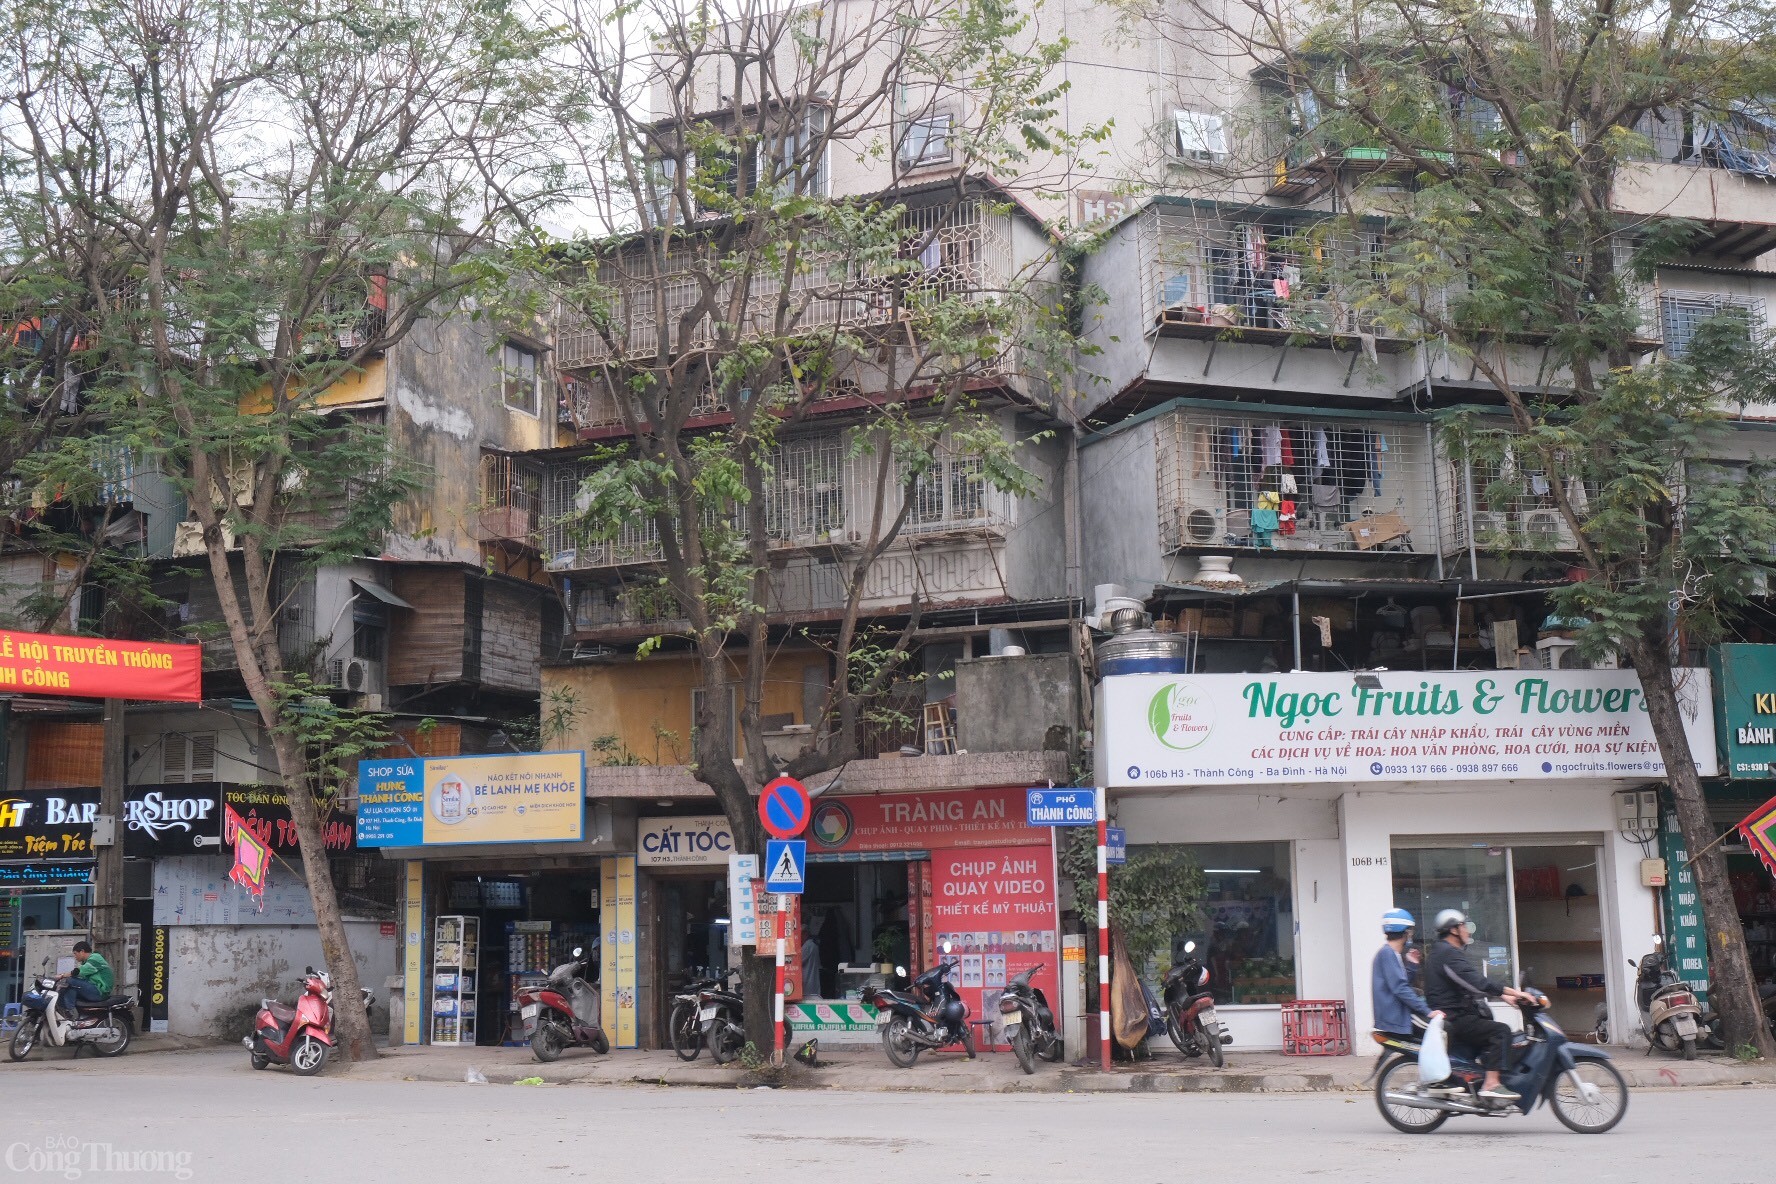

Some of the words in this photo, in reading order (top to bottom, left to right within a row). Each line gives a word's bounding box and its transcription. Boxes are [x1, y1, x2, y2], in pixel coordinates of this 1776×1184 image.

[18, 641, 49, 664] HỘI
[52, 643, 118, 666] TRUYỀN
[121, 648, 173, 670] THỐNG
[22, 666, 70, 688] CÔNG
[1242, 682, 1343, 728] Ngọc
[1351, 682, 1463, 716] Fruits
[1472, 678, 1505, 715] &
[1171, 713, 1192, 721] Fruits
[1173, 724, 1179, 732] &
[1181, 723, 1208, 732] Flowers
[1279, 730, 1314, 741] CUNG
[1318, 725, 1346, 741] CẤP:
[1351, 727, 1379, 740] TRÁI
[1383, 727, 1407, 740] CÂY
[1410, 726, 1446, 741] NHẬP
[1450, 723, 1490, 740] KHẨU,
[1495, 725, 1524, 738] TRÁI
[1531, 725, 1555, 738] CÂY
[1558, 723, 1593, 737] VÙNG
[1596, 721, 1630, 736] MIỀN
[1738, 721, 1773, 744] BÁNH
[1251, 746, 1275, 759] CÁC
[1278, 748, 1309, 761] DỊCH
[1314, 747, 1331, 760] VỤ
[1335, 742, 1352, 757] VỀ
[1355, 746, 1386, 757] HOA:
[1390, 746, 1417, 756] HOA
[1422, 743, 1448, 756] VĂN
[1452, 742, 1499, 756] PHÒNG,
[1505, 744, 1531, 755] HOA
[1535, 741, 1569, 755] CƯỚI,
[1574, 743, 1601, 754] HOA
[1604, 742, 1623, 756] SỰ
[1626, 740, 1657, 755] KIỆN
[368, 767, 393, 777] SHOP
[535, 772, 562, 780] NHANH
[1144, 769, 1168, 778] 106b
[1171, 769, 1184, 778] H3
[1193, 768, 1225, 777] Thành
[1227, 767, 1254, 779] Công
[1266, 767, 1279, 776] Ba
[1282, 766, 1305, 776] Đình
[1315, 766, 1328, 775] Hà
[1331, 766, 1347, 777] Nội
[1385, 765, 1408, 774] 0933
[1411, 764, 1427, 773] 137
[1430, 764, 1447, 773] 666
[1456, 764, 1479, 773] 0938
[1481, 763, 1498, 772] 897
[1501, 763, 1518, 772] 666
[491, 784, 521, 795] LANH
[524, 783, 540, 796] MẸ
[359, 792, 393, 804] THÀNH
[394, 791, 423, 803] CÔNG
[1055, 793, 1077, 803] PHỐ
[467, 807, 478, 815] 5G
[880, 797, 964, 823] TRÀNG
[972, 799, 1005, 820] AN
[1031, 805, 1064, 821] THÀNH
[1066, 804, 1093, 820] CÔNG
[855, 827, 878, 836] CHỤP
[881, 824, 898, 834] ẢNH
[904, 826, 929, 834] QUAY
[931, 825, 953, 833] PHIM
[959, 821, 985, 831] THIẾT
[988, 820, 1000, 830] KẾ
[25, 834, 58, 856] Tiệm
[61, 832, 86, 853] Tóc
[643, 825, 681, 853] CẮT
[685, 827, 731, 852] TÓC
[950, 861, 996, 878] CHỤP
[1001, 855, 1037, 875] ẢNH
[1352, 857, 1372, 866] 106B
[1375, 857, 1388, 866] H3
[1678, 869, 1691, 884] CÂY
[943, 880, 989, 896] QUAY
[994, 879, 1045, 895] VIDEO
[1678, 891, 1696, 907] NHẬP
[936, 901, 970, 915] THIẾT
[973, 900, 989, 915] KẾ
[992, 902, 1010, 914] MỸ
[1013, 900, 1054, 915] THUẬT
[154, 928, 165, 991] 0966130069
[1682, 958, 1703, 970] KOREA
[817, 1023, 846, 1031] FUJIFILM
